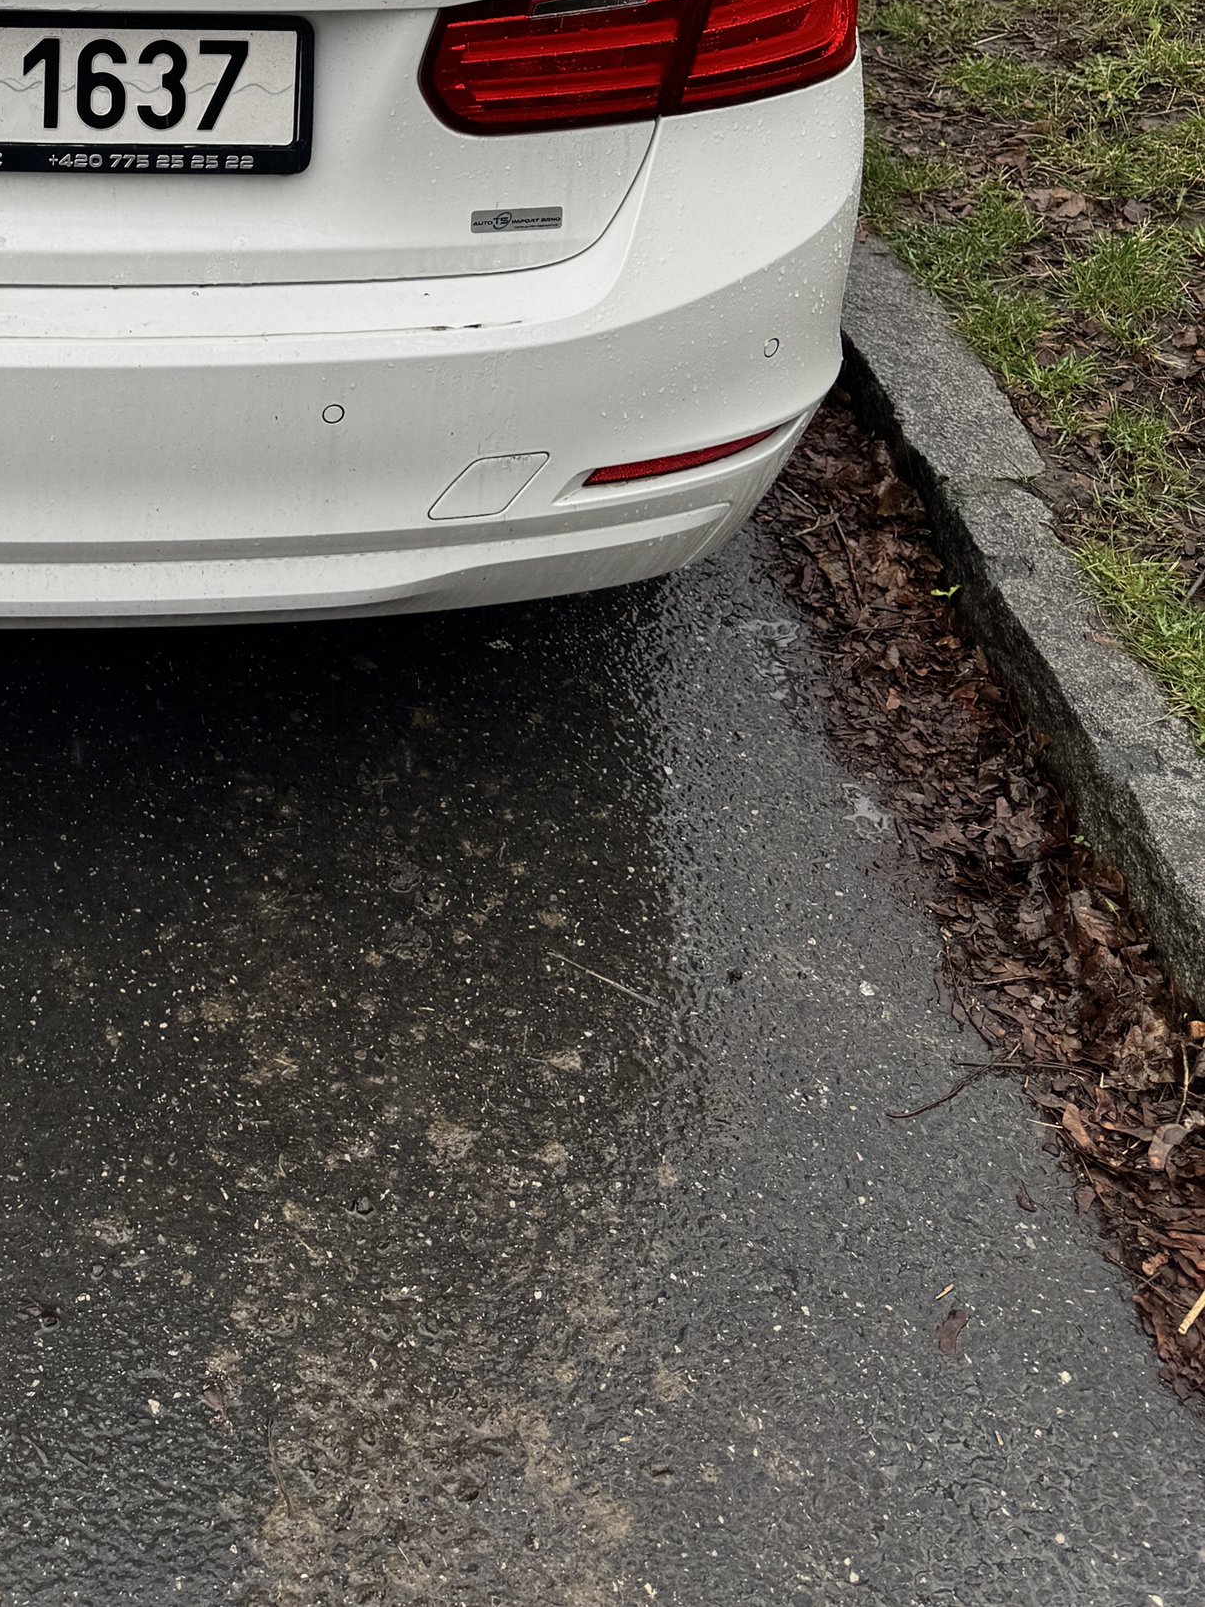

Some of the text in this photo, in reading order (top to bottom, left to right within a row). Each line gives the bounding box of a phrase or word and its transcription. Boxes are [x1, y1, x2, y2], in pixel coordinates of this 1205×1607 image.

[22, 37, 250, 131] 1637
[49, 153, 254, 169] +420 775 25 25 22
